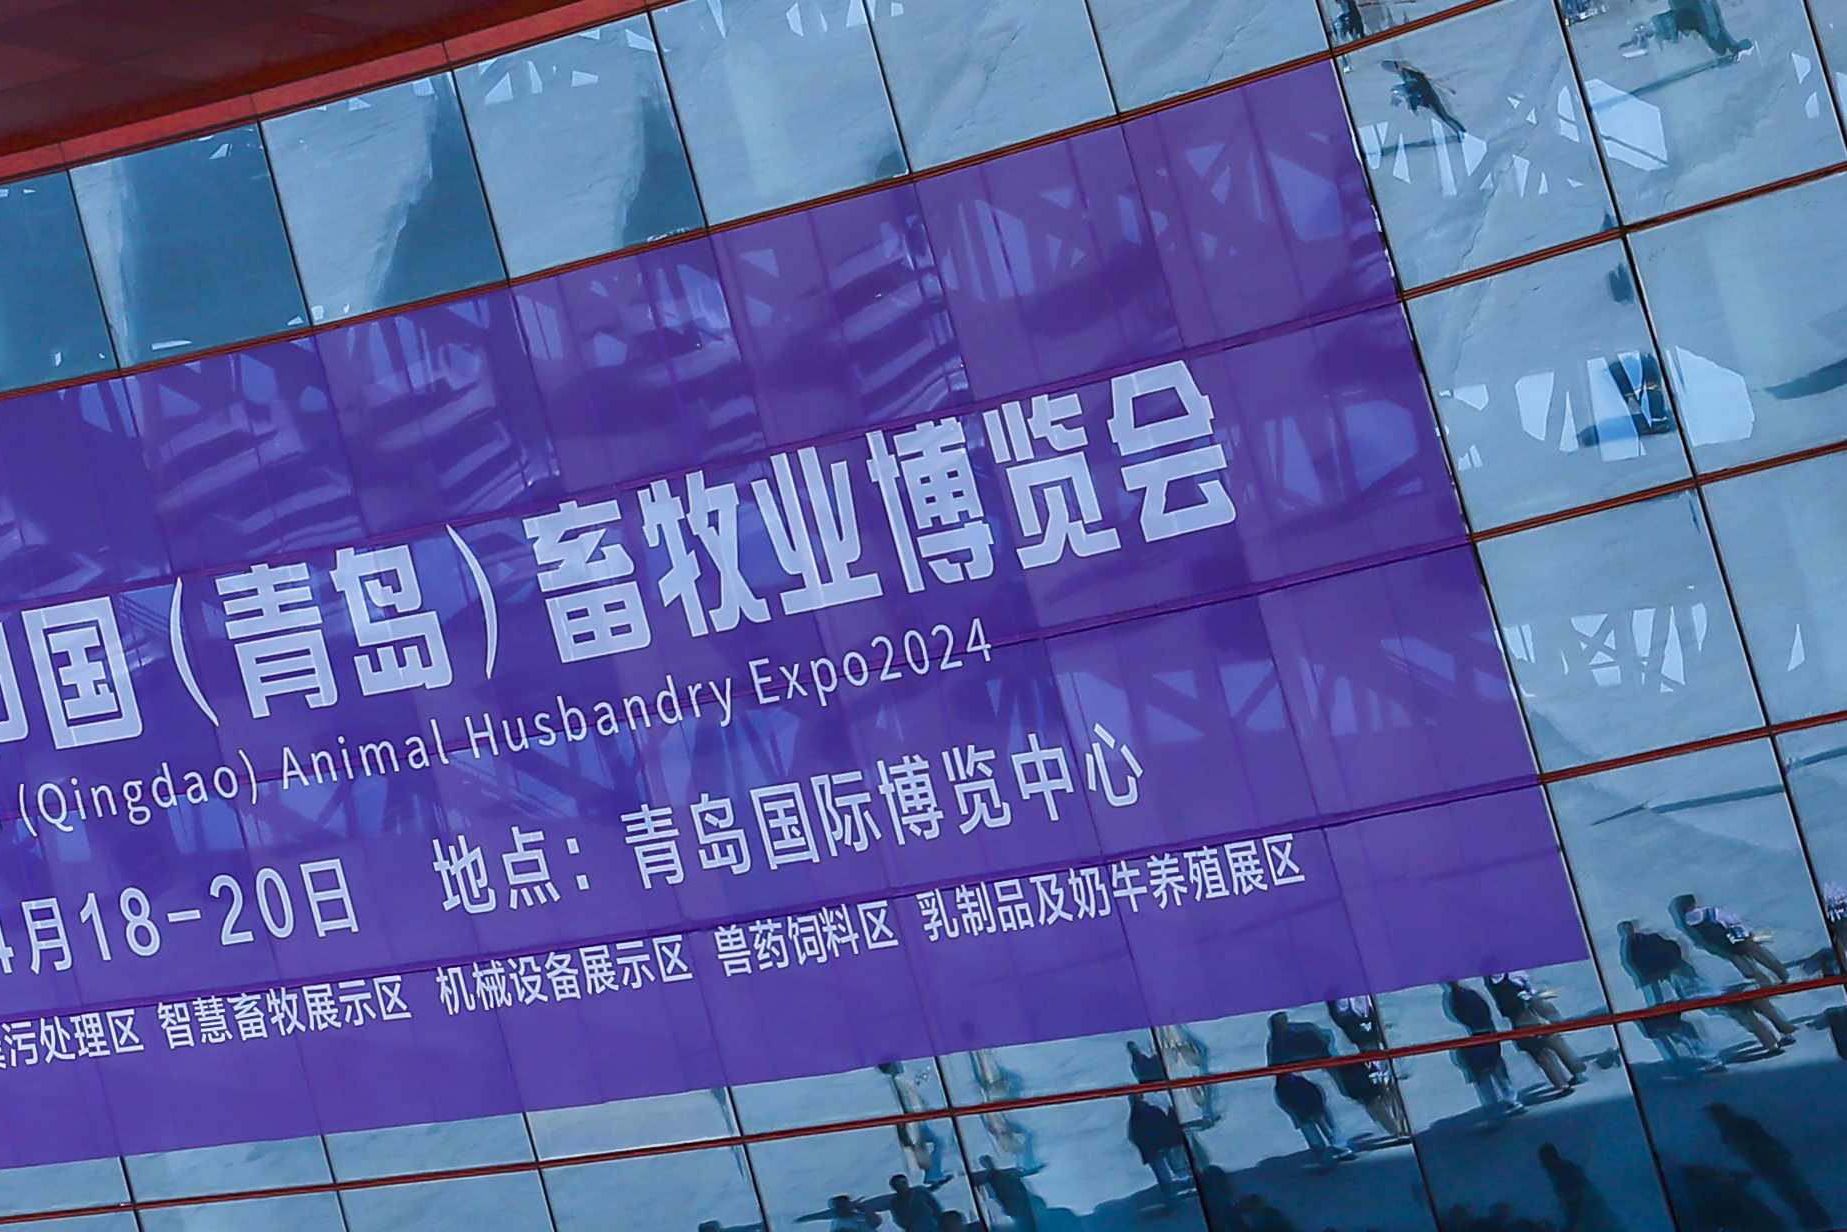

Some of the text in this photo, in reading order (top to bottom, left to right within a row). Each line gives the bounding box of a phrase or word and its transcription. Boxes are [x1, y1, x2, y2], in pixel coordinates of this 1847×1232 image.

[18, 749, 258, 838] (Qingdao)
[280, 723, 451, 791] Animal
[464, 673, 733, 759] Husbandry
[748, 618, 993, 707] Expo2024
[157, 975, 412, 1050] 智慧畜牧展示区
[436, 934, 693, 1016] 机械设备展示区
[714, 898, 899, 977] 兽药饲料区
[915, 832, 1306, 943] 乳制品及奶牛养殖展区
